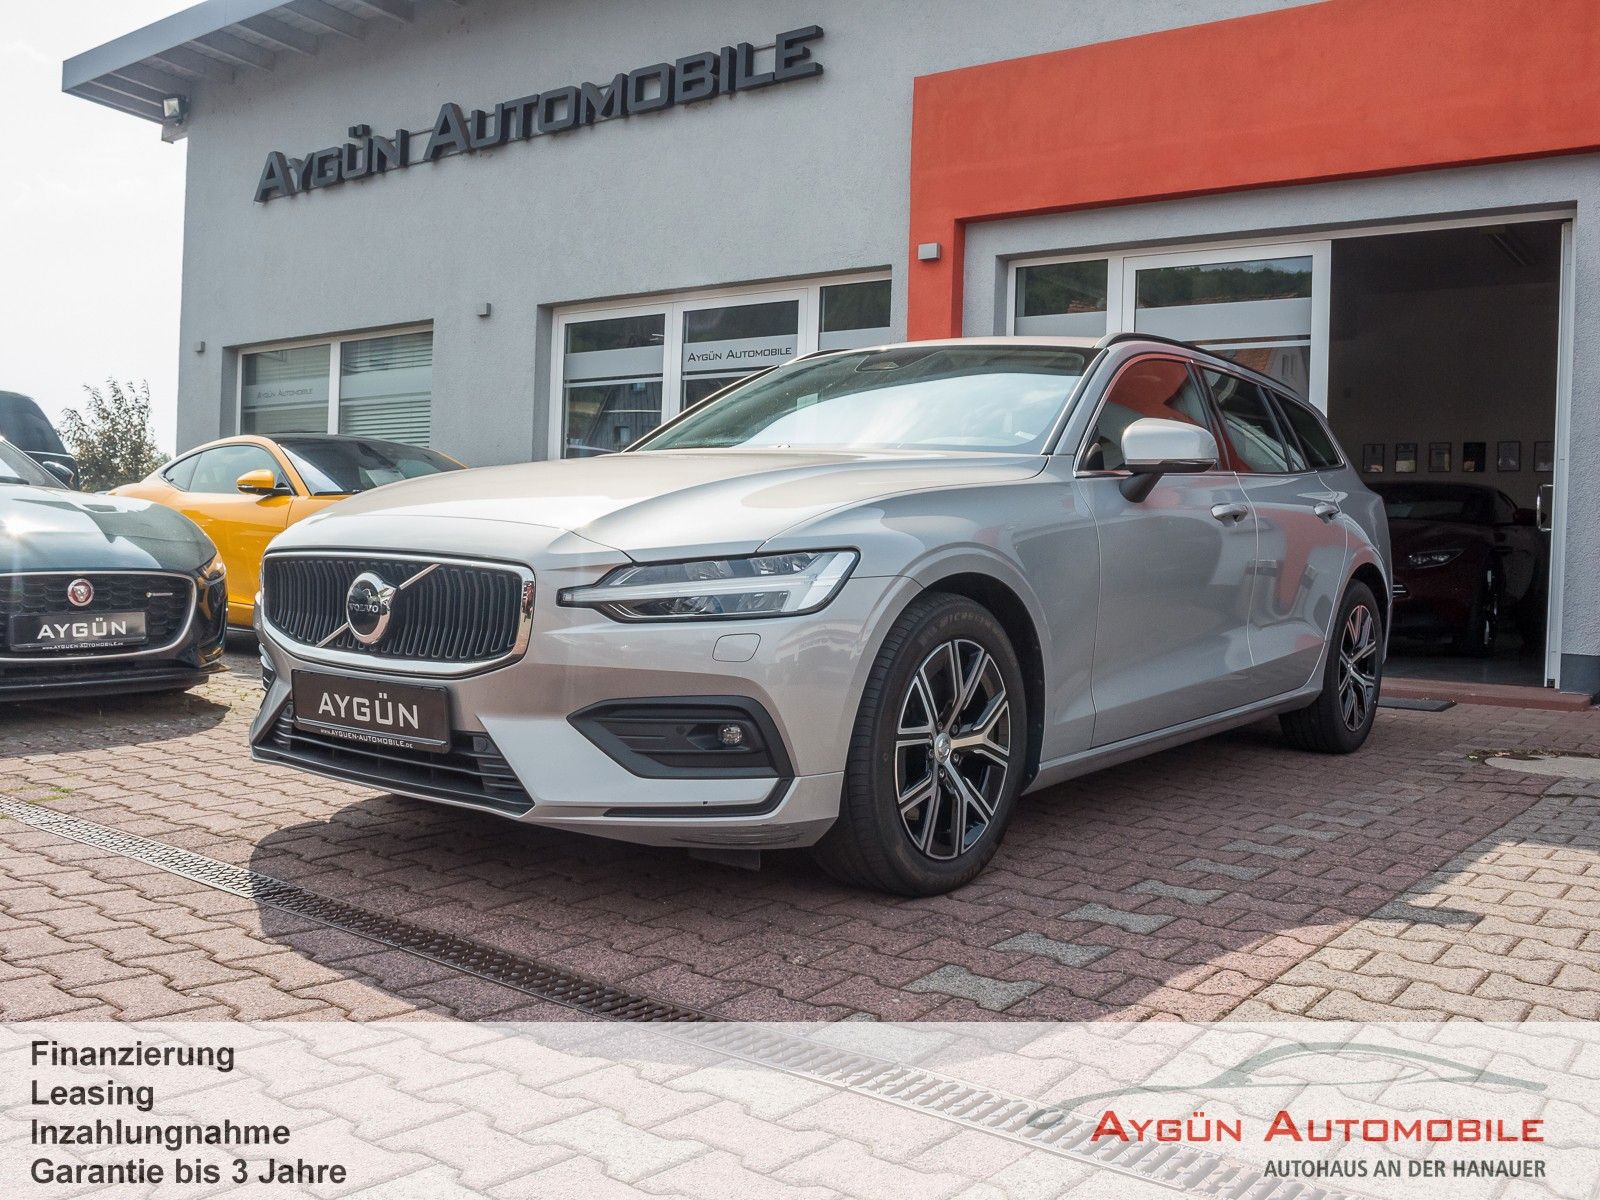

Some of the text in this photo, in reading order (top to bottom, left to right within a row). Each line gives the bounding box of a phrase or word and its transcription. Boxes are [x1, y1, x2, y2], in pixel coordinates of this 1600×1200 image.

[253, 25, 824, 202] AYGÜN AUTOMOBILE
[687, 347, 792, 362] AYGÜN AUTOMOBILE
[37, 617, 127, 640] AYGÜN
[318, 692, 419, 729] AYGÜN
